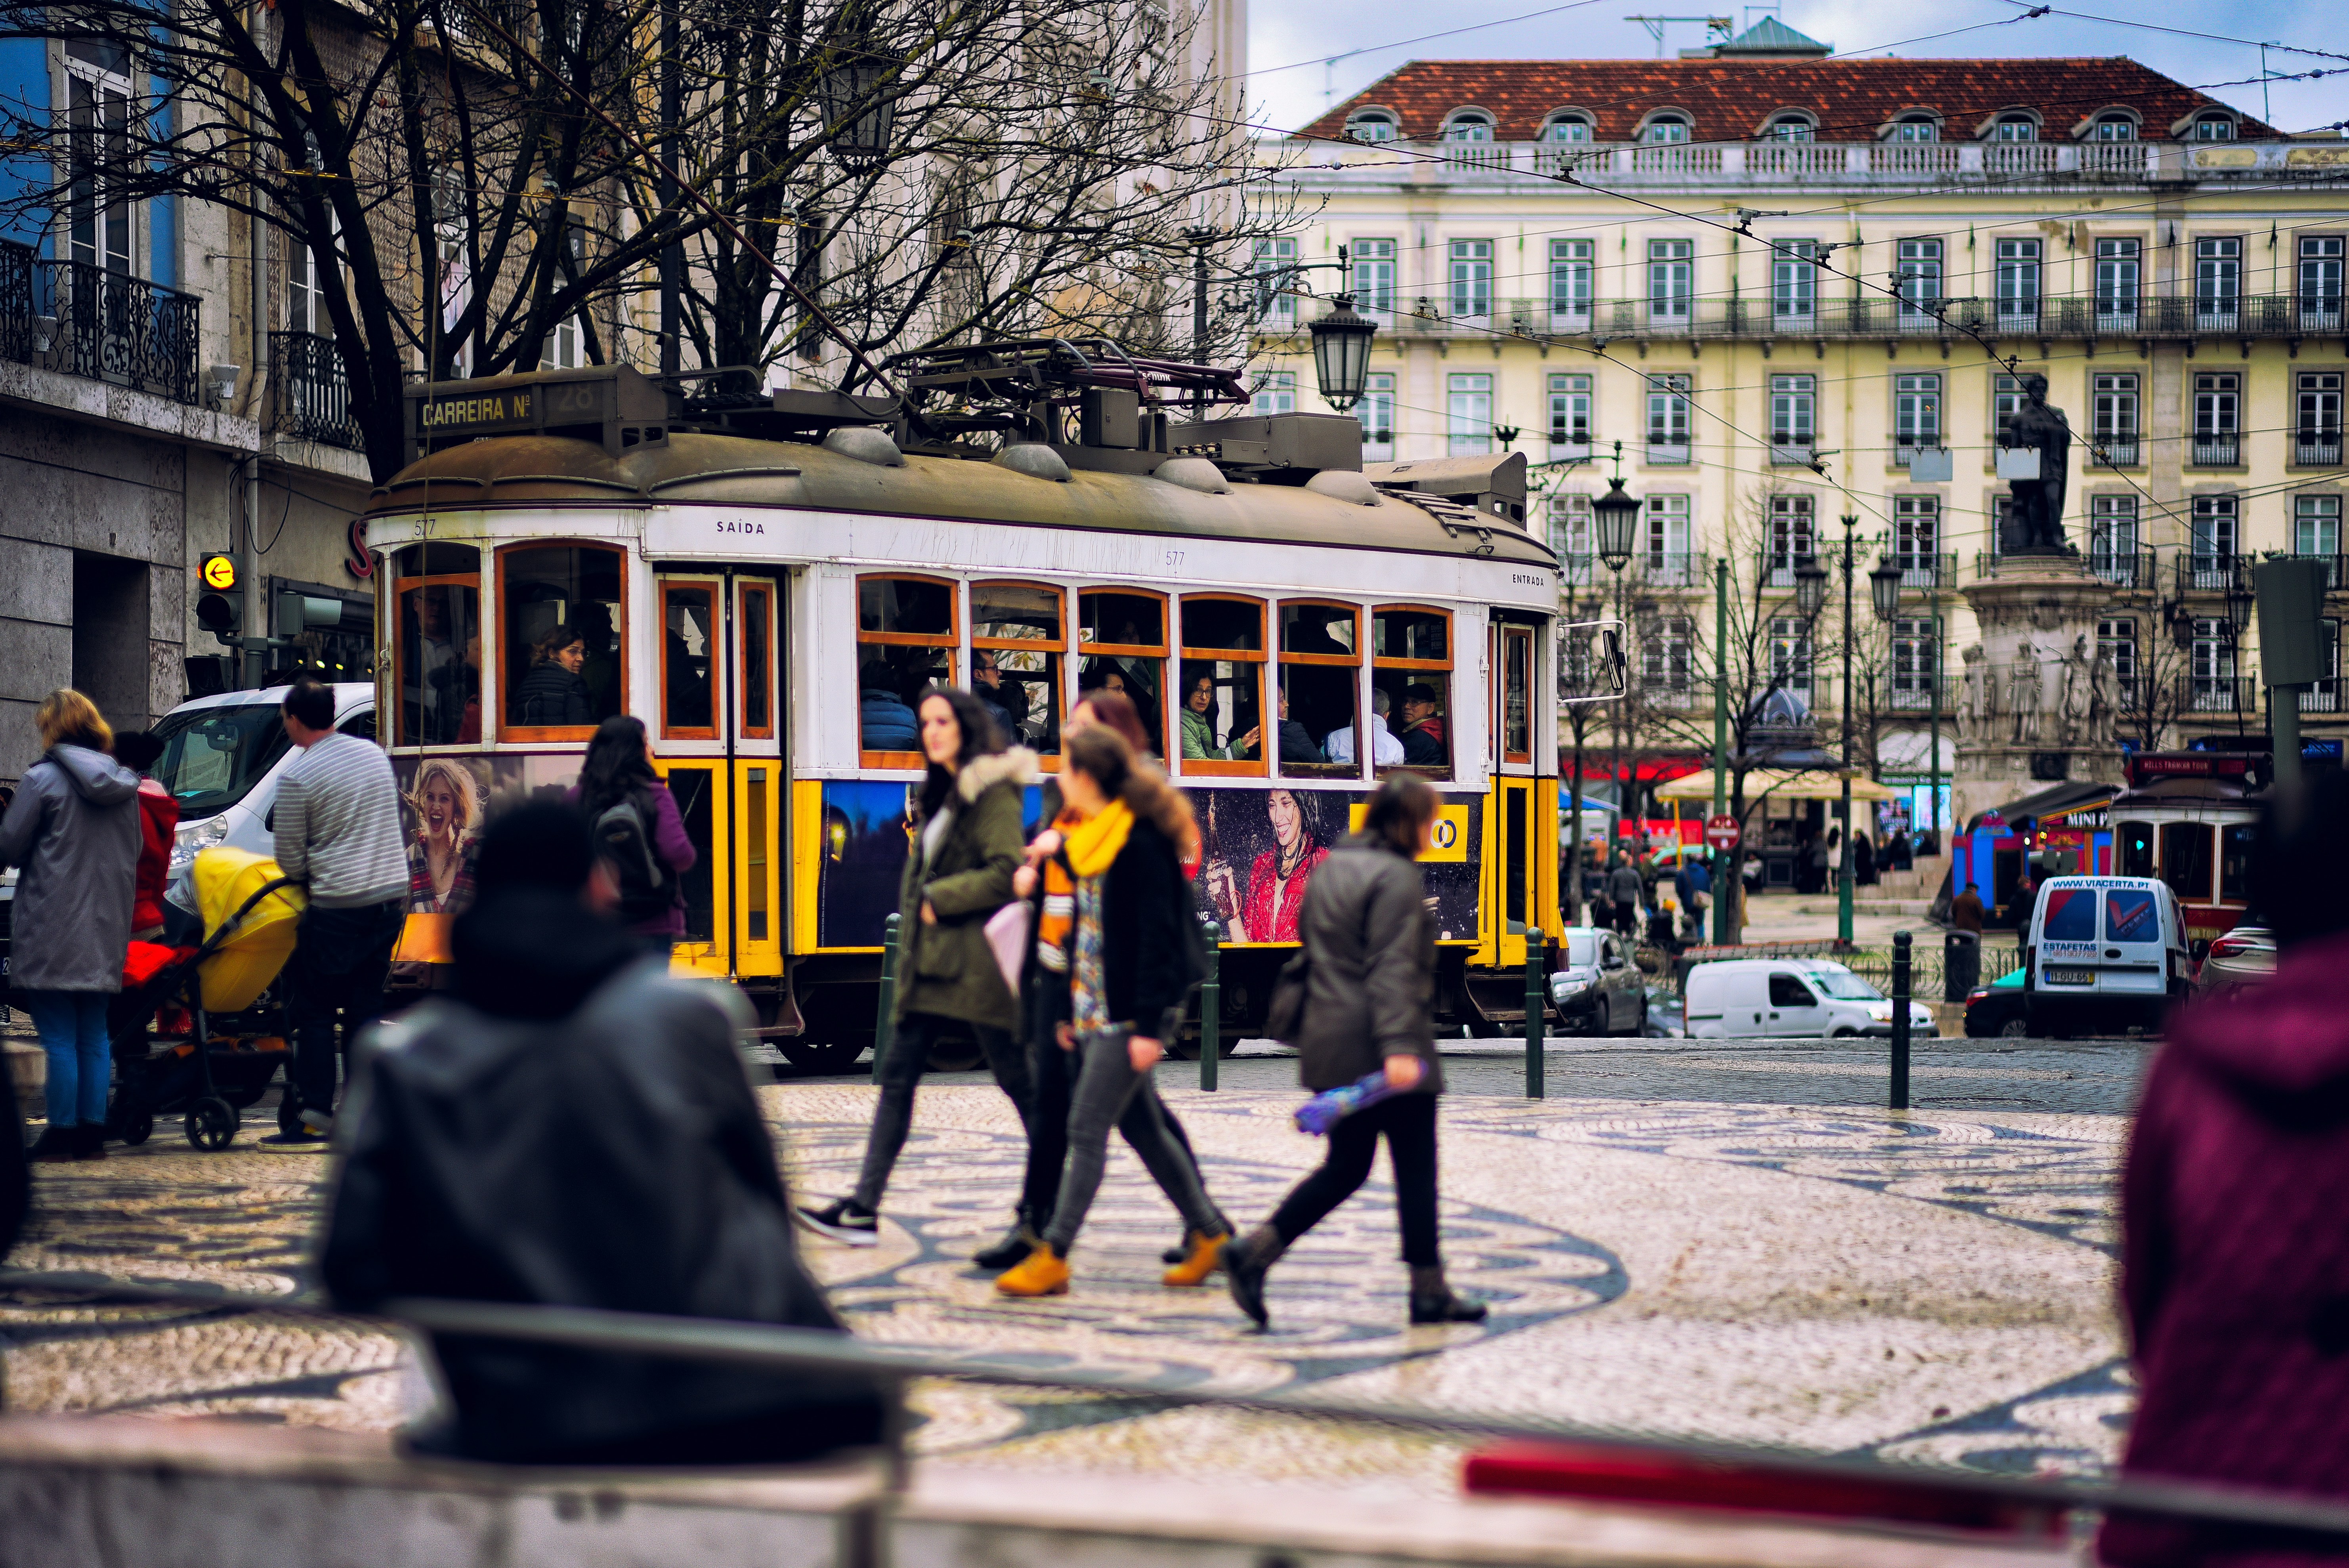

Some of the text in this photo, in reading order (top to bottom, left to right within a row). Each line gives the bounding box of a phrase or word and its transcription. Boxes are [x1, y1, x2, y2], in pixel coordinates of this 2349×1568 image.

[423, 397, 504, 426] CARREIRA
[558, 383, 593, 412] 28
[414, 519, 436, 536] 577
[716, 518, 764, 534] SAÍDA
[1166, 551, 1185, 565] 577
[1513, 574, 1544, 587] ENTRADA
[2043, 943, 2097, 951] ESTAFETAS
